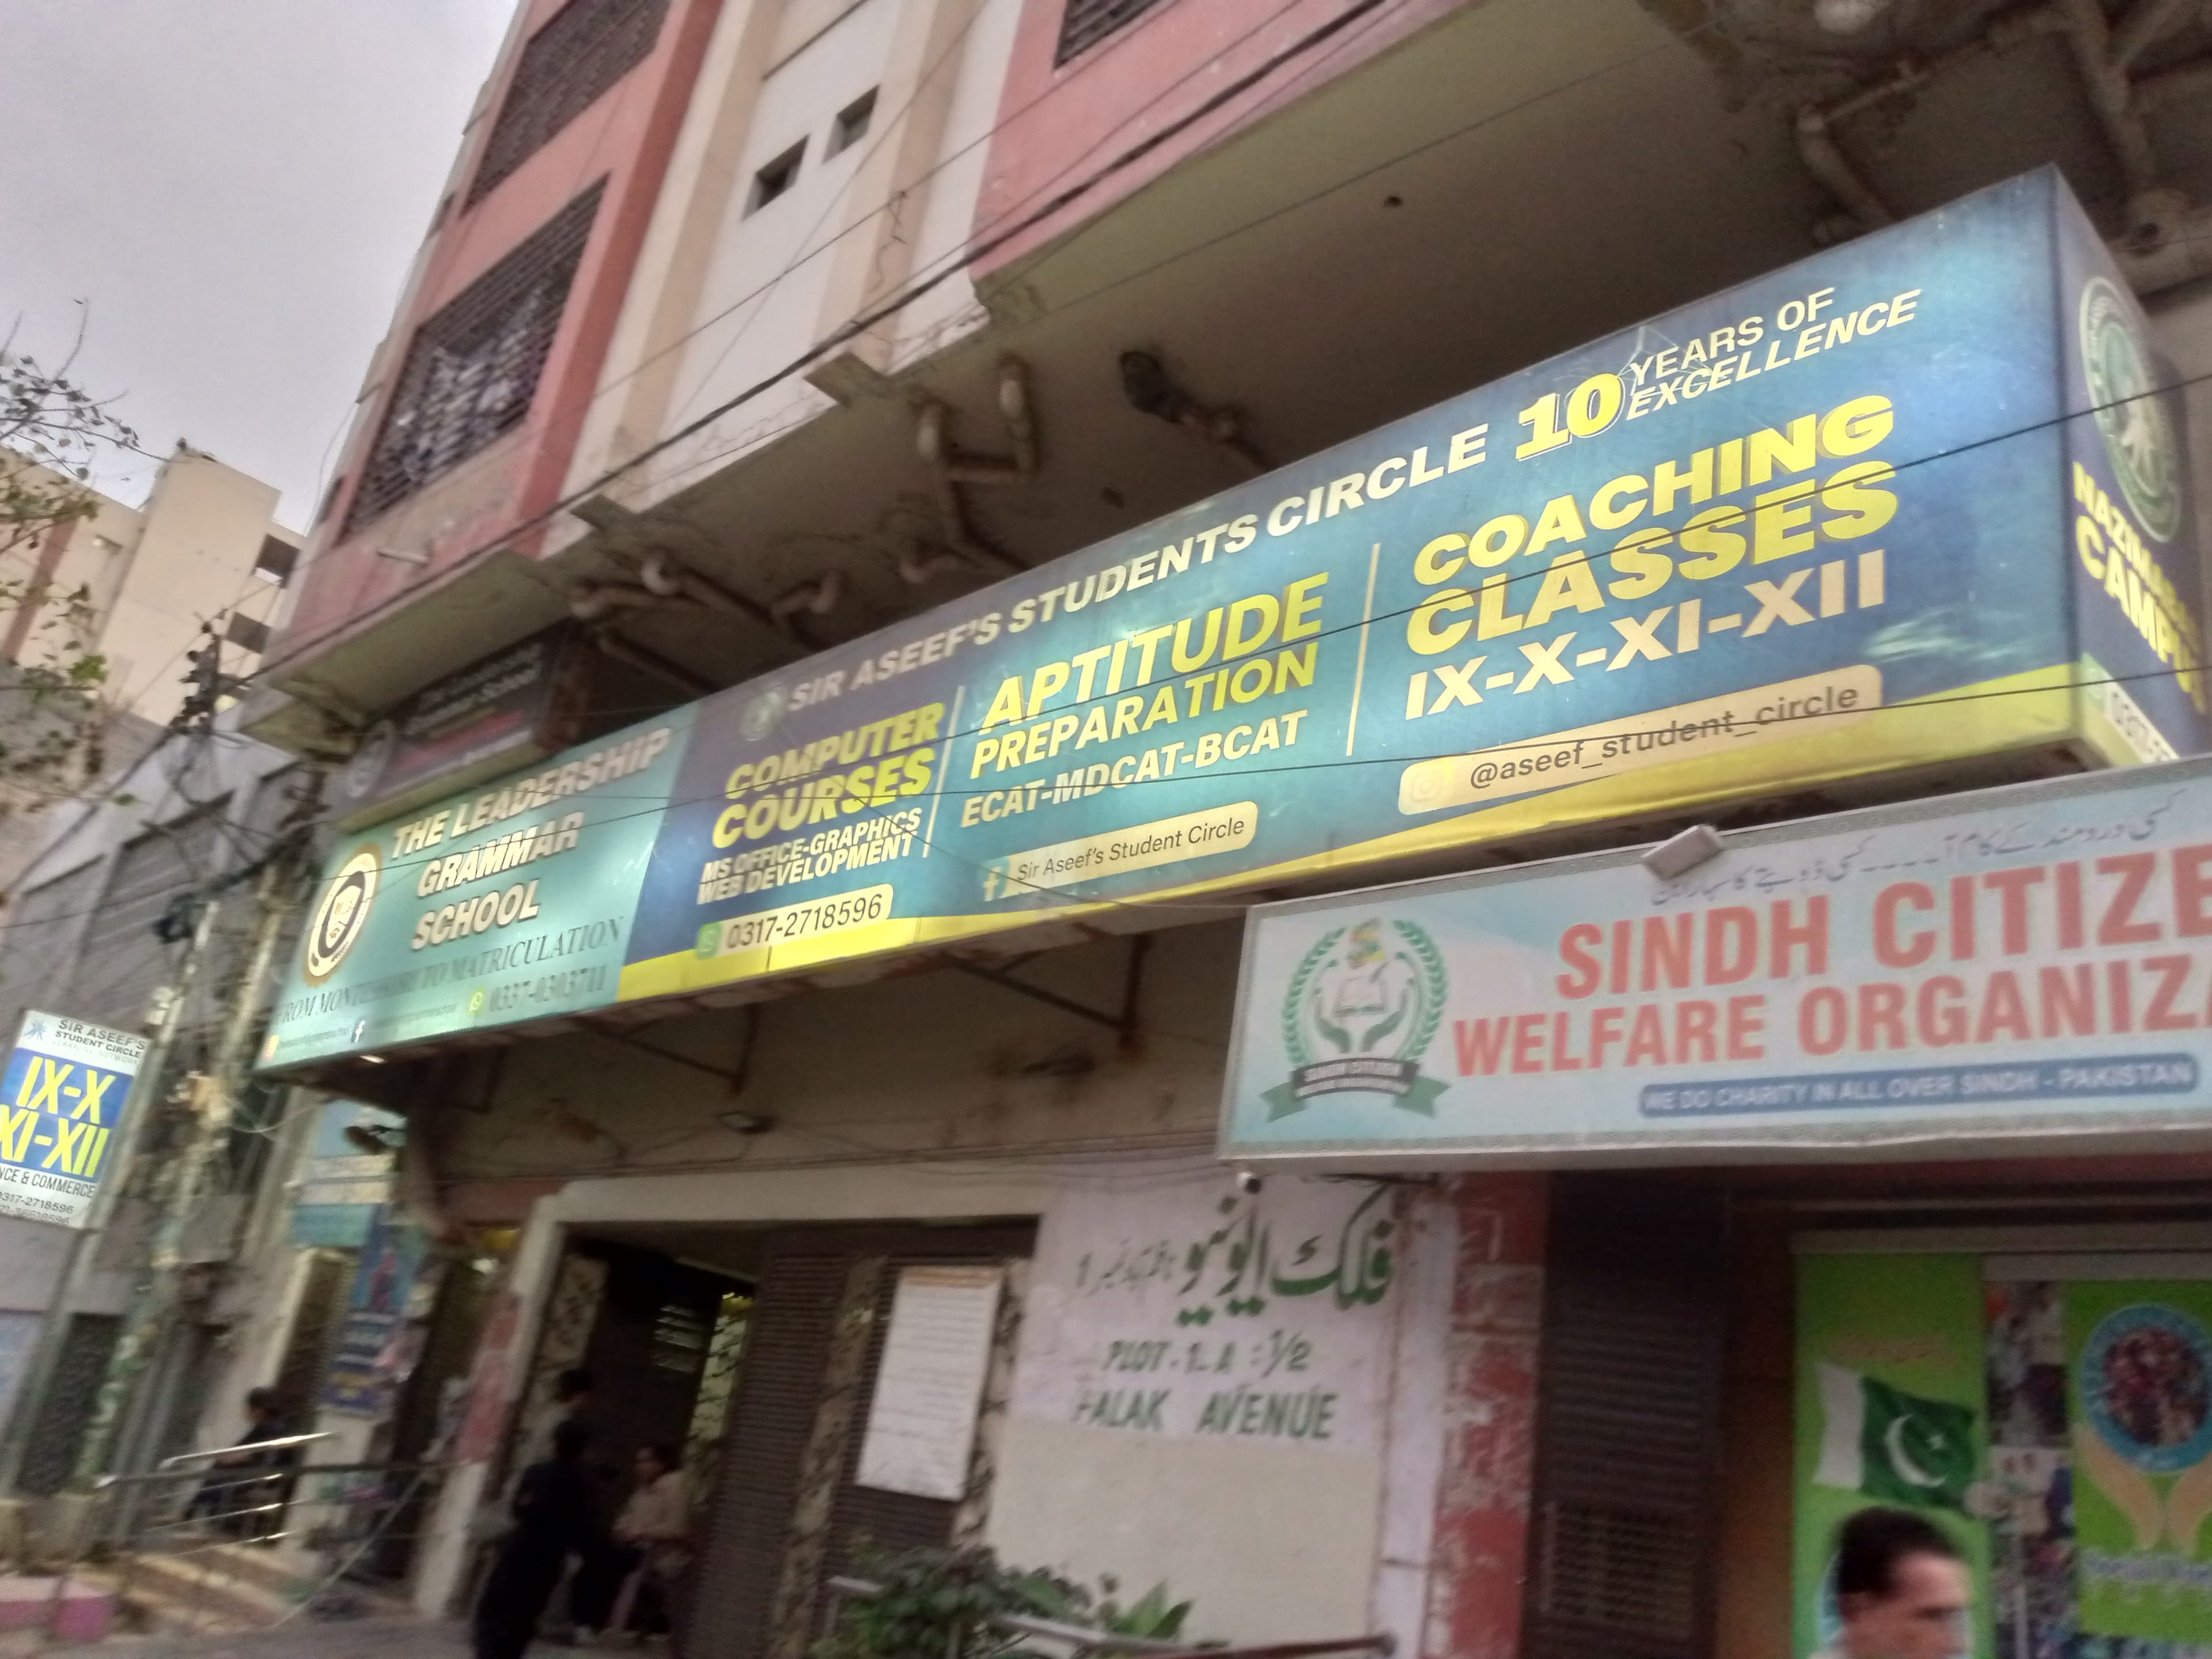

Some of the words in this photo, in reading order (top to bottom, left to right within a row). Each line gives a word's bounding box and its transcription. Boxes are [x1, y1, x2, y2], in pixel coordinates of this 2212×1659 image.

[1626, 289, 1921, 422] EXCELLENCE
[1629, 315, 1764, 387] YEARS
[1776, 287, 1835, 331] OF
[1413, 394, 1894, 586] COACHING
[787, 671, 846, 711] SIR
[850, 612, 1002, 691] ASEEF'S
[1007, 513, 1258, 634] STUDENTS
[1267, 423, 1488, 537] CIRCLE
[1514, 372, 1626, 461] 10
[1406, 460, 1899, 655] CLASSES
[978, 571, 1329, 737] APTITUDE
[1404, 550, 1885, 721] IX-X-XI-XII
[725, 703, 944, 800] COMPUTER
[969, 642, 1319, 779] PREPARATION
[1469, 685, 1858, 790] @aseef_student_circle
[390, 809, 451, 859] THE
[450, 728, 672, 839] LEADERSHIP
[711, 747, 935, 849] COURSES
[961, 710, 1308, 829] ECAT-MDCAT-BCAT
[417, 811, 586, 897] GRAMMAR
[697, 874, 744, 905] WEB
[747, 830, 917, 892] DEVELOPMENT
[701, 859, 732, 882] MS
[733, 807, 922, 873] OFFICE-GRAPHICS
[1017, 862, 1039, 882] Sir
[1043, 847, 1104, 875] Aseef's
[1109, 831, 1181, 862] Student
[1187, 817, 1245, 844] Circle
[410, 878, 541, 951] SCHOOL
[452, 915, 626, 980] MATRICULATION
[726, 893, 882, 949] 0317-2718596
[1554, 895, 1830, 1001] SINDH
[55, 1031, 103, 1048] STUDENT
[106, 1044, 142, 1058] CIRCLE
[59, 1020, 83, 1033] SIR
[86, 1028, 146, 1050] ASEEF'S
[1454, 994, 1766, 1078] WELFARE
[1798, 953, 2212, 1058] ORGANIZ
[17, 1056, 116, 1124] IX-X
[1644, 1092, 1675, 1111] WE
[1680, 1090, 1712, 1108] DO
[1715, 1084, 1809, 1108] CHARITY
[1812, 1082, 1834, 1103] IN
[1836, 1080, 1881, 1100] ALL
[1887, 1073, 1954, 1098] OVER
[1960, 1071, 2039, 1094] SINDH
[2058, 1063, 2190, 1089] PAKISTAN
[0, 1104, 111, 1178] XI-XII
[21, 1172, 30, 1184] &
[31, 1173, 96, 1198] COMMERCE
[1195, 1384, 1340, 1440] AVENUE
